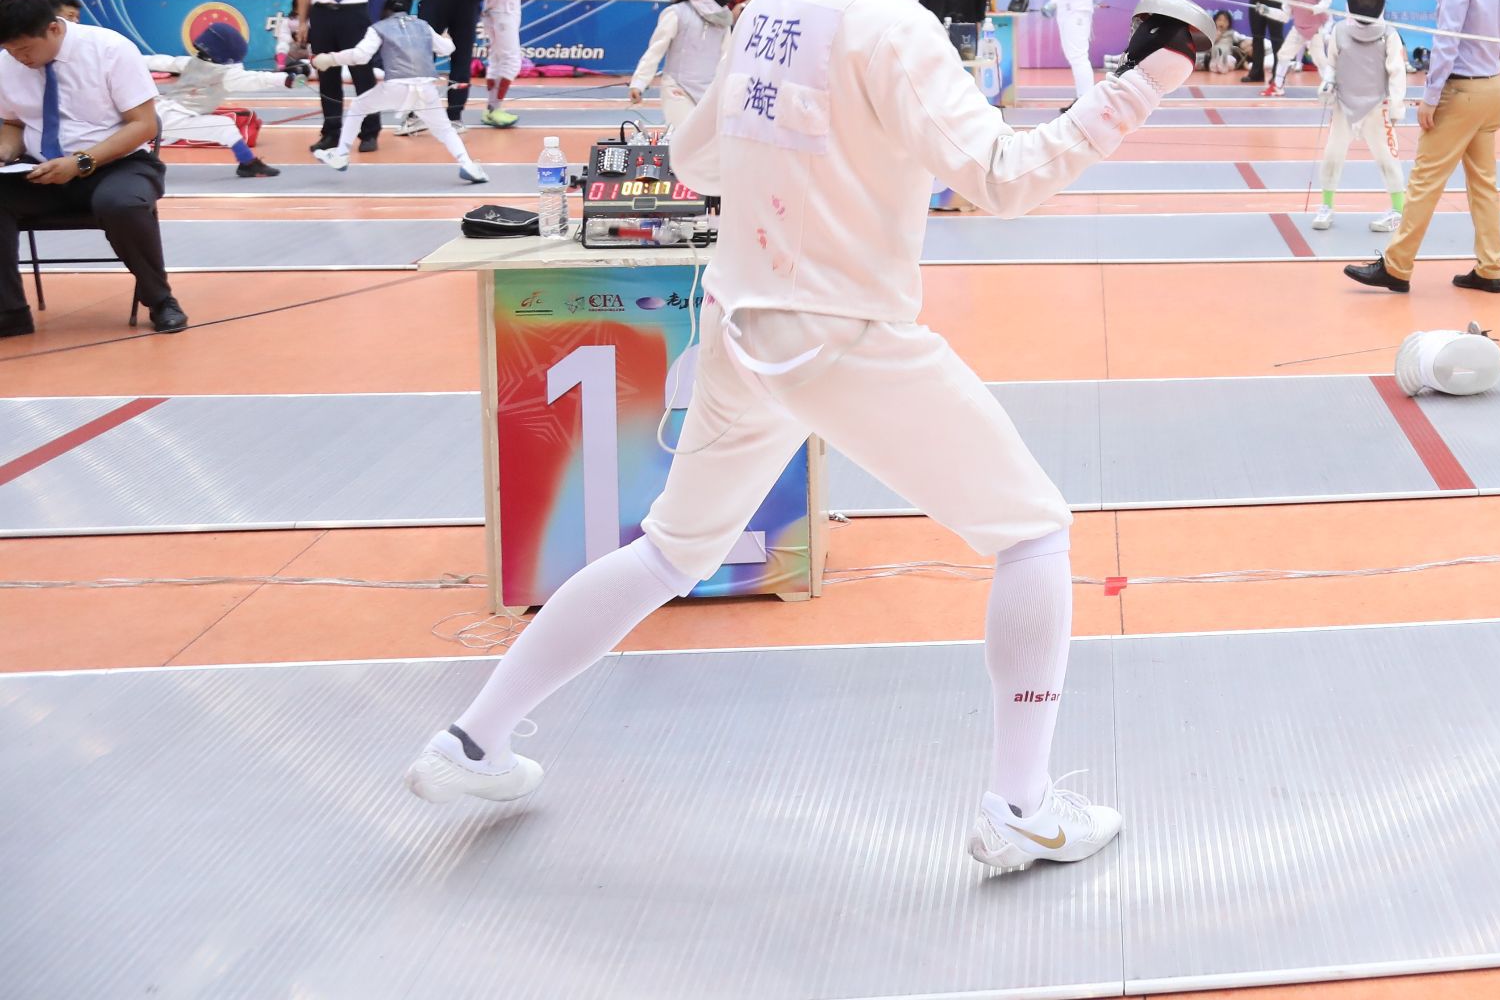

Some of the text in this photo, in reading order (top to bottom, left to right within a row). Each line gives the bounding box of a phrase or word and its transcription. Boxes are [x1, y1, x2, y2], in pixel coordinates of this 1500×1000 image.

[520, 43, 604, 59] ssociation
[588, 182, 620, 200] 01
[621, 181, 671, 196] 00:17
[588, 294, 624, 308] CFA
[1014, 690, 1061, 702] allstar
